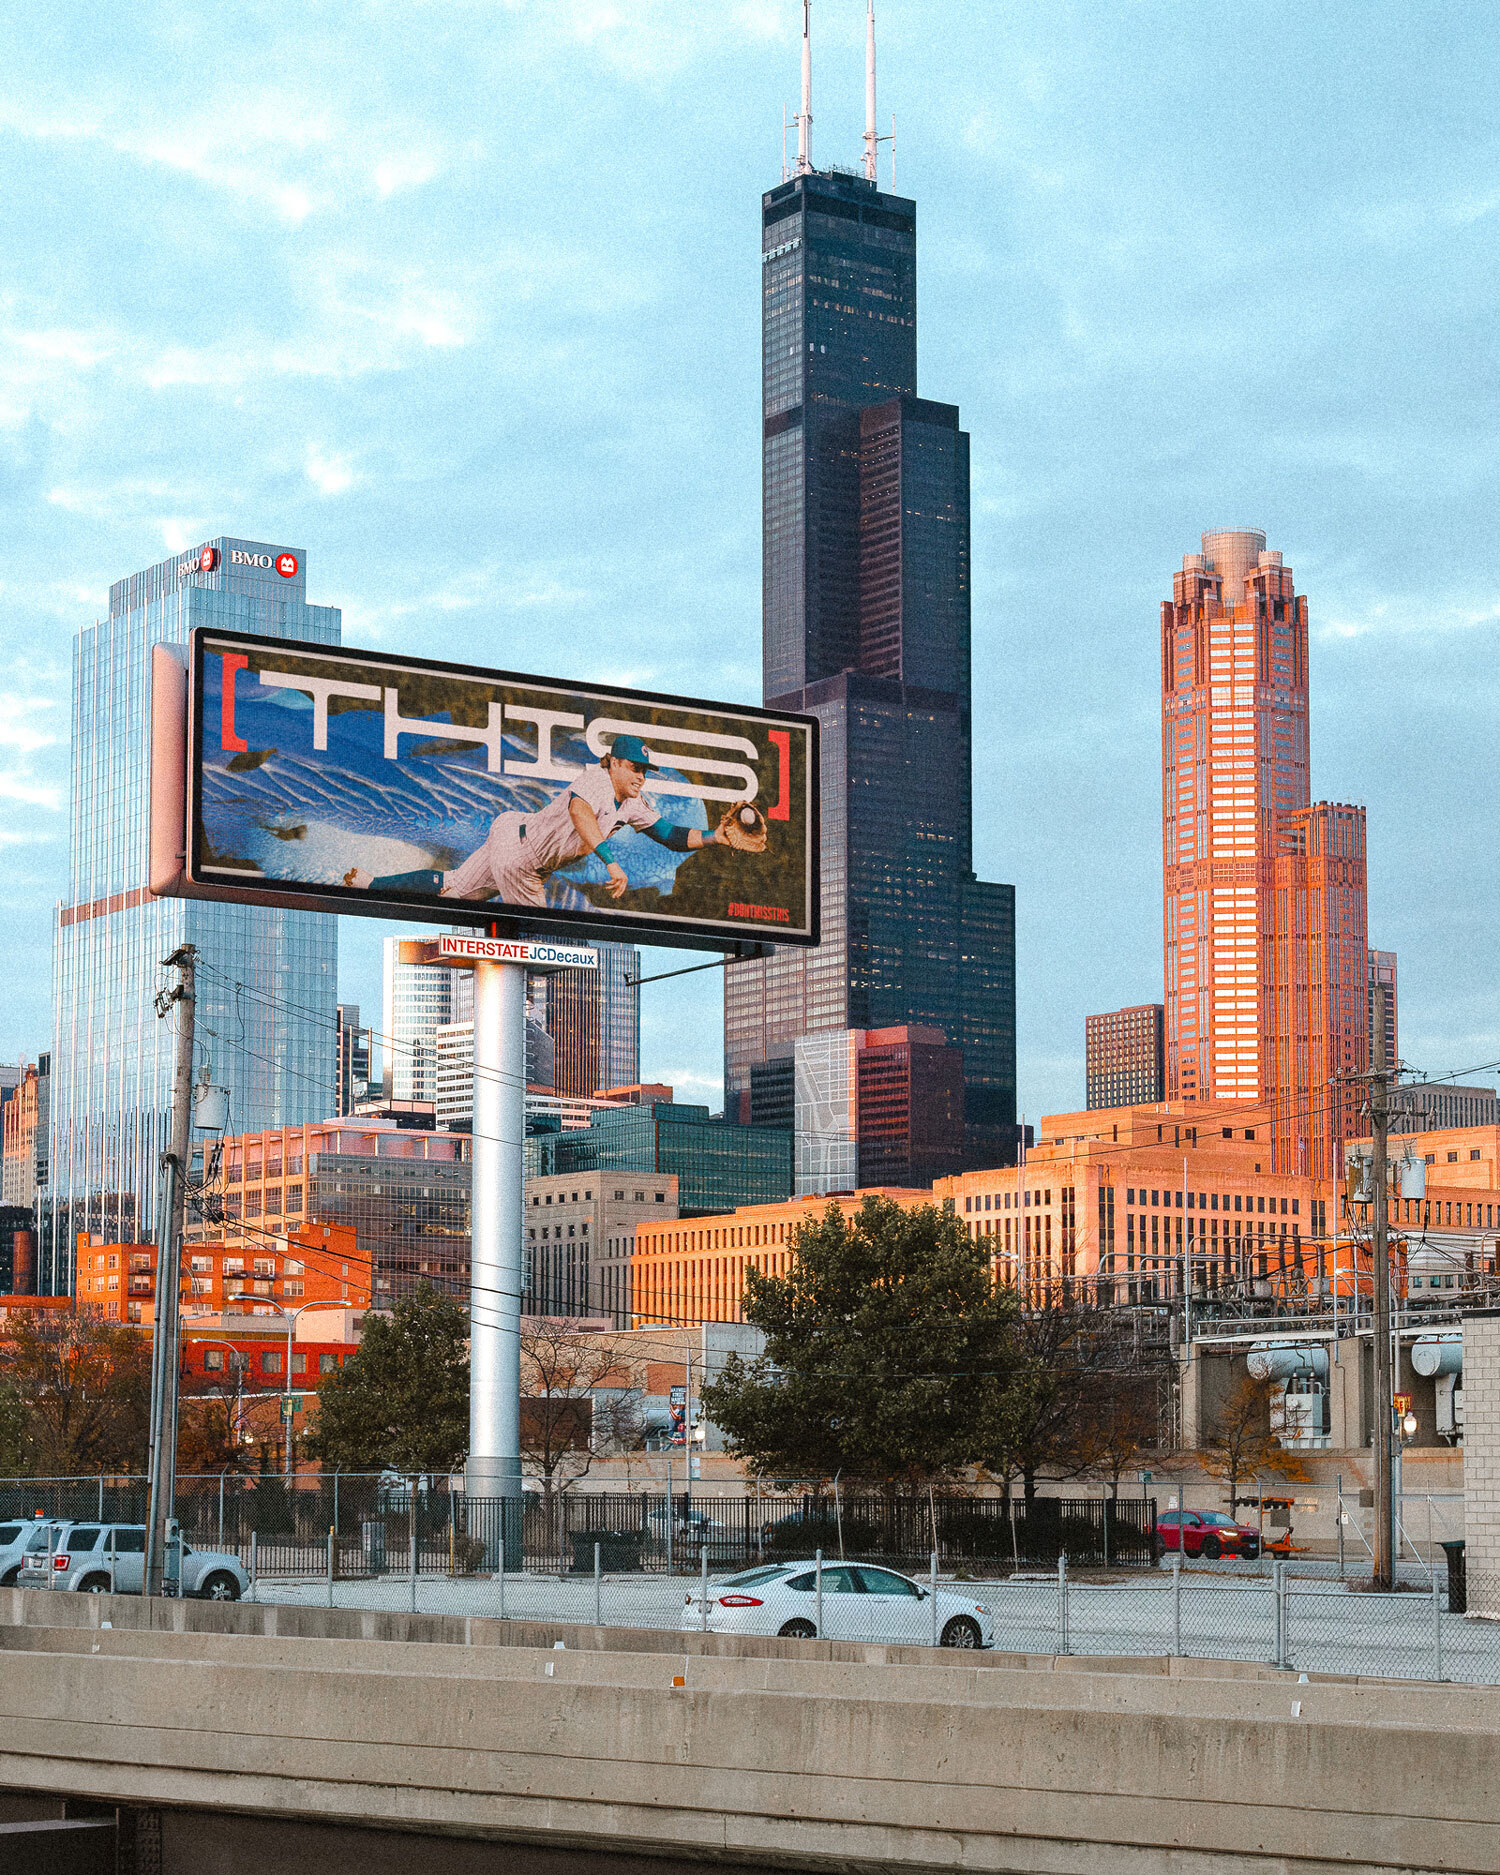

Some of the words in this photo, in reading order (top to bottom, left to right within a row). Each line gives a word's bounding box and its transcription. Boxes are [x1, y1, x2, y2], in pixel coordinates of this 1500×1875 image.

[177, 557, 200, 577] BMO
[231, 549, 272, 568] BMO
[727, 901, 790, 922] #DONTMISSTHIS
[442, 937, 529, 959] INTERSTATE
[529, 946, 595, 966] JCDecaux
